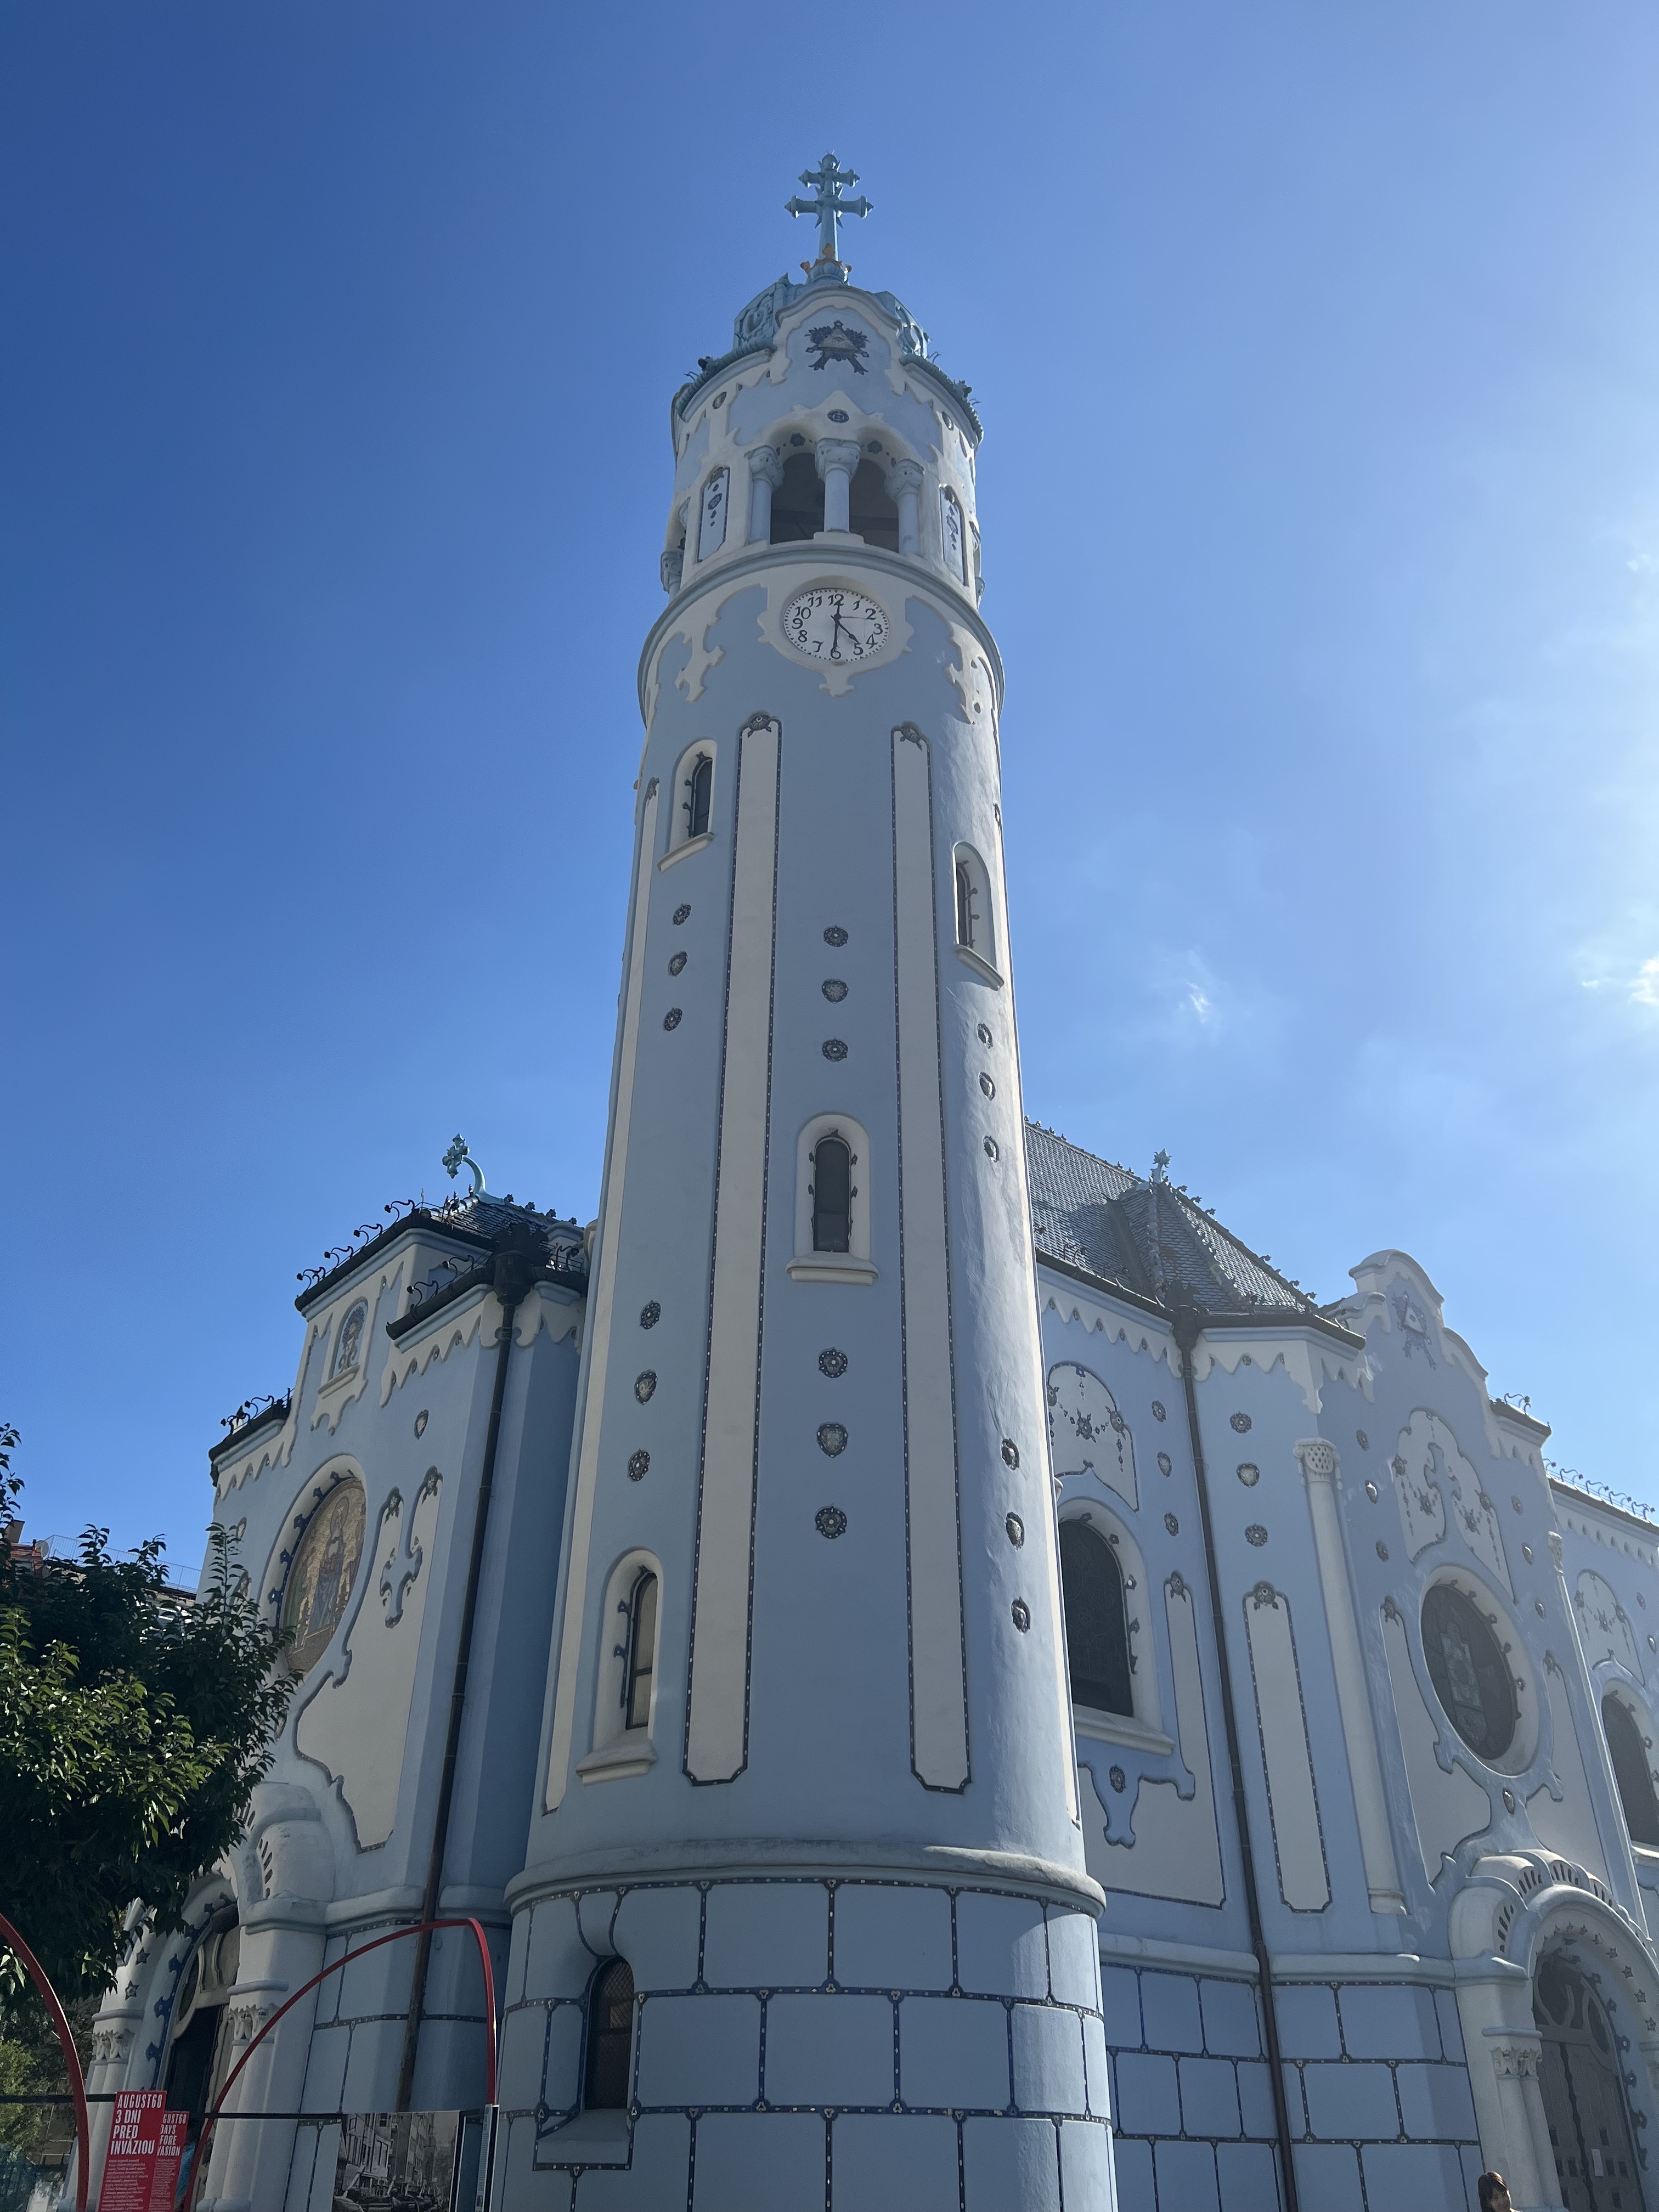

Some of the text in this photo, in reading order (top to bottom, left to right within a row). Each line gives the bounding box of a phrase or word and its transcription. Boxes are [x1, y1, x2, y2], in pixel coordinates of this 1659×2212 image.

[808, 596, 822, 607] 11
[827, 594, 845, 606] 12
[853, 600, 861, 611] 1
[795, 606, 811, 619] 10
[865, 608, 877, 620] 2
[792, 618, 803, 629] 9
[873, 623, 883, 635] 3
[798, 630, 808, 642] 8
[866, 634, 878, 650] 4
[812, 640, 824, 652] 7
[853, 642, 864, 656] 5
[830, 647, 842, 659] 6
[117, 2094, 163, 2108] AUGUST68
[115, 2109, 142, 2124] 3 DNI
[162, 2113, 187, 2124] GUST68
[112, 2125, 139, 2139] PRED
[159, 2135, 177, 2145] FORE
[110, 2138, 155, 2155] INVÁZIOU
